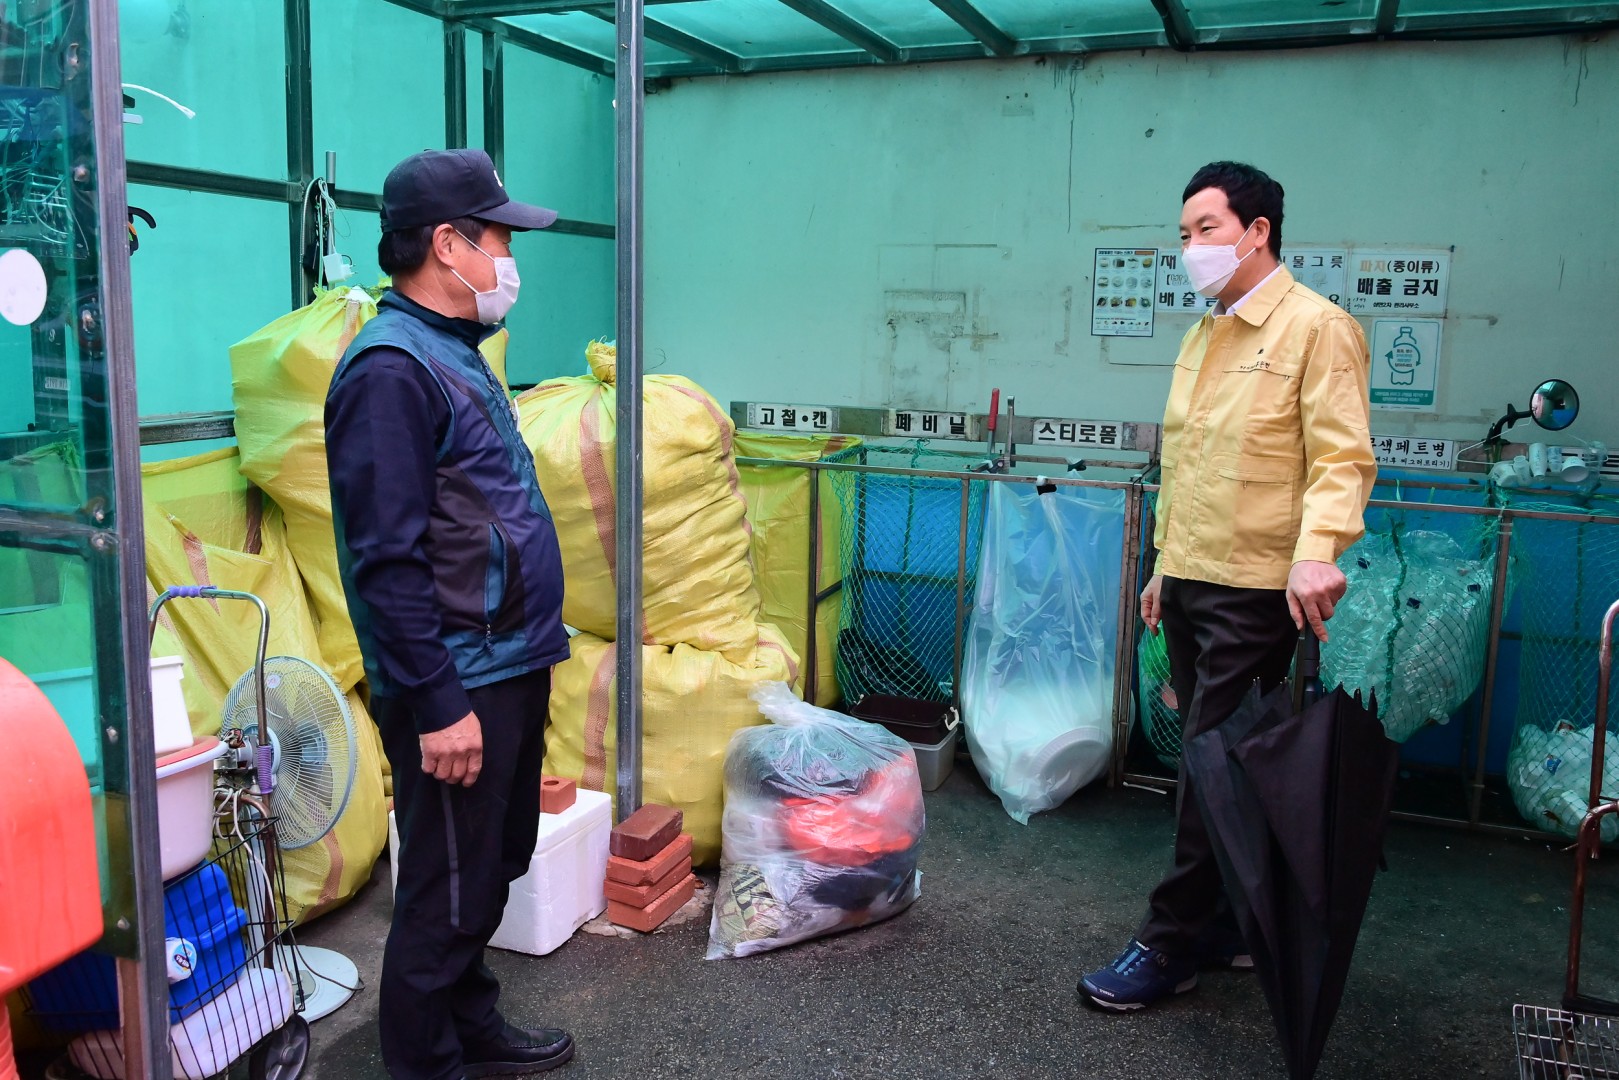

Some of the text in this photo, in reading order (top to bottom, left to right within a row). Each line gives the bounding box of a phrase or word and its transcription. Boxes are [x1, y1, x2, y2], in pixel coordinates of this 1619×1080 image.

[1357, 278, 1439, 296] 배출 금지
[1038, 422, 1117, 444] 스티로폼
